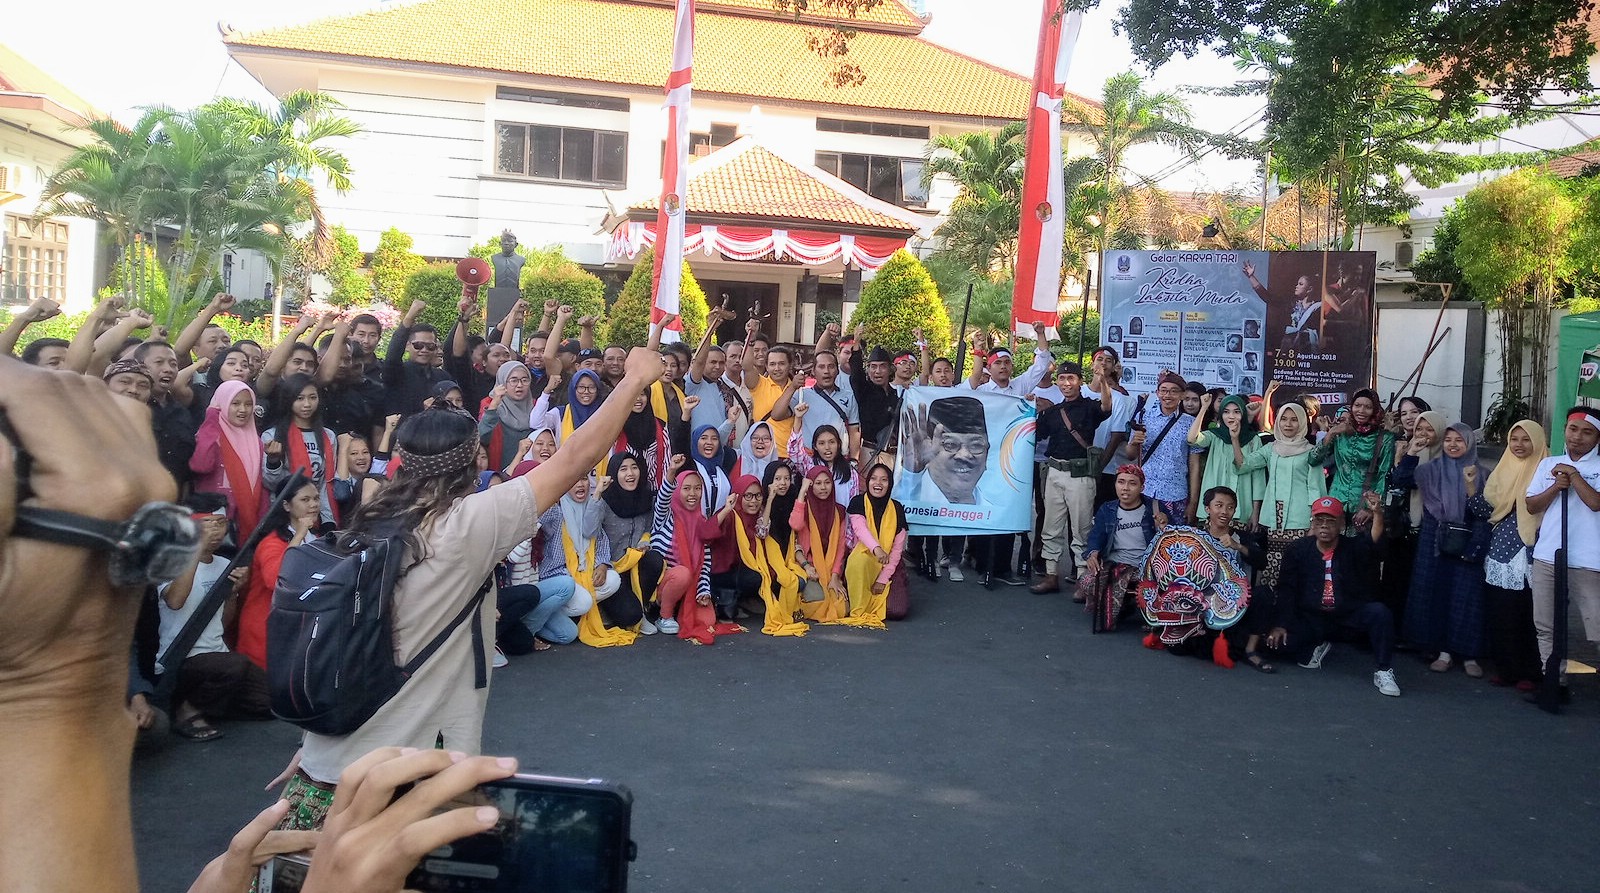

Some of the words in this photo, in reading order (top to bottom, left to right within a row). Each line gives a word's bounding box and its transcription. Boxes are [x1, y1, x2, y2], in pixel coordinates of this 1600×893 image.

[1150, 253, 1176, 263] Gelar
[1178, 253, 1212, 263] KARYA
[1215, 253, 1239, 263] TARI
[1145, 267, 1207, 290] Kridha
[1134, 284, 1192, 304] Laksita
[1187, 284, 1247, 305] Muda
[1274, 348, 1281, 358] 7
[1288, 349, 1295, 359] 8
[1296, 352, 1320, 360] Agustus
[1321, 353, 1337, 361] 2018
[1273, 358, 1296, 367] 19.00
[1273, 368, 1293, 376] Gedung
[1580, 367, 1594, 377] ILO
[1317, 394, 1340, 403] ATIS
